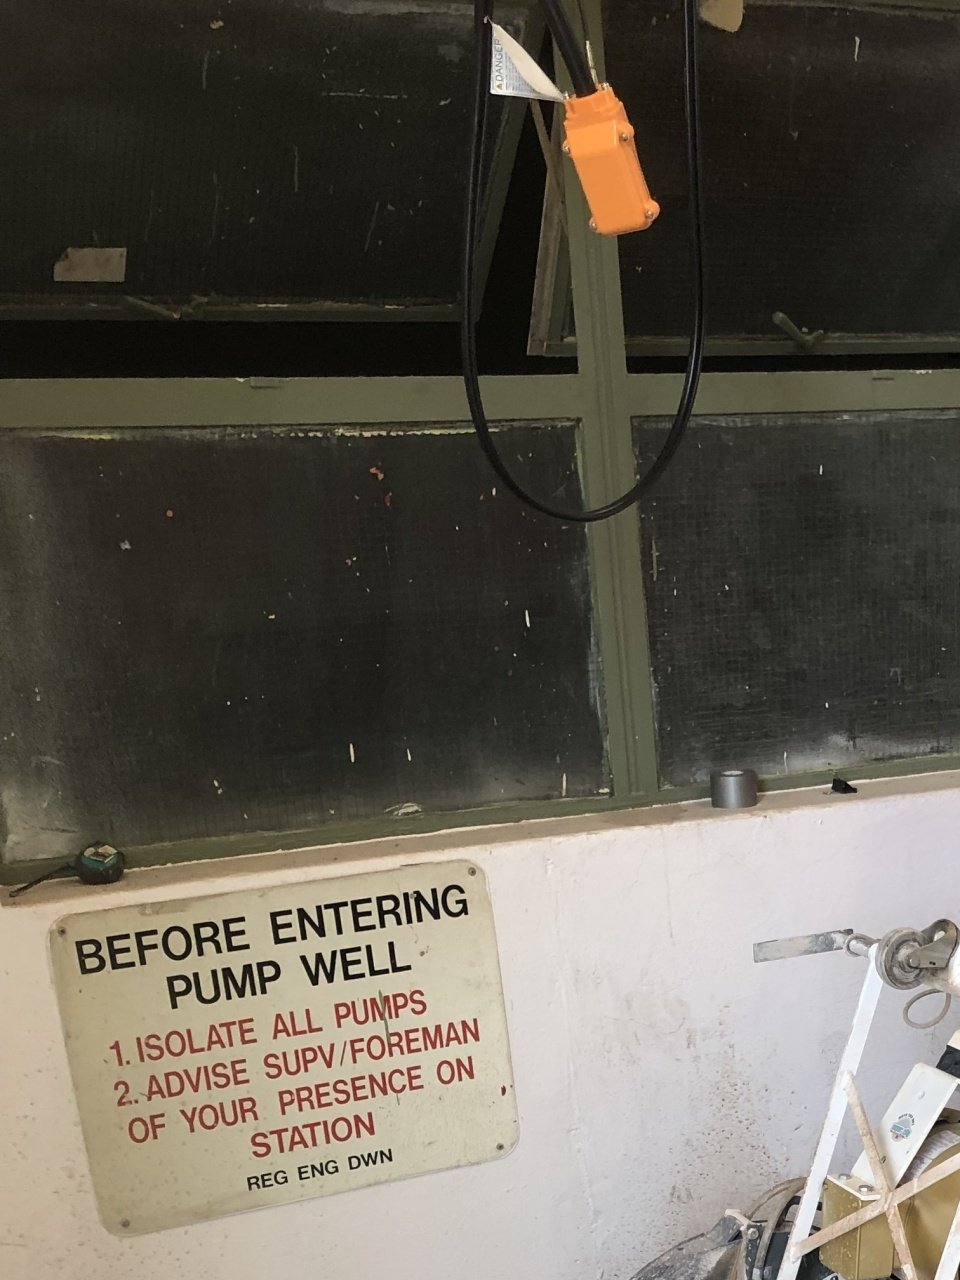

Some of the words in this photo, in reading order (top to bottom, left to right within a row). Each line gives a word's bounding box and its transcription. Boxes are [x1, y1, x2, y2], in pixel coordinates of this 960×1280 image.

[495, 38, 503, 82] DANGER
[75, 916, 251, 975] BEFORE
[268, 883, 470, 945] ENTERING
[166, 960, 282, 1010] PUMP
[300, 941, 412, 987] WELL
[109, 1040, 131, 1067] 1.
[136, 1018, 258, 1062] ISOLATE
[272, 1007, 323, 1041] ALL
[334, 989, 427, 1029] PUMPS
[113, 1080, 139, 1107] 2.
[146, 1058, 249, 1102] ADVISE
[127, 1112, 166, 1144] OF
[179, 1096, 259, 1134] YOUR
[277, 1068, 425, 1116] PRESENCE
[436, 1056, 476, 1093] ON
[250, 1112, 376, 1159] STATION
[246, 1169, 289, 1191] REG
[297, 1159, 340, 1182] ENG
[348, 1148, 394, 1171] DWN
